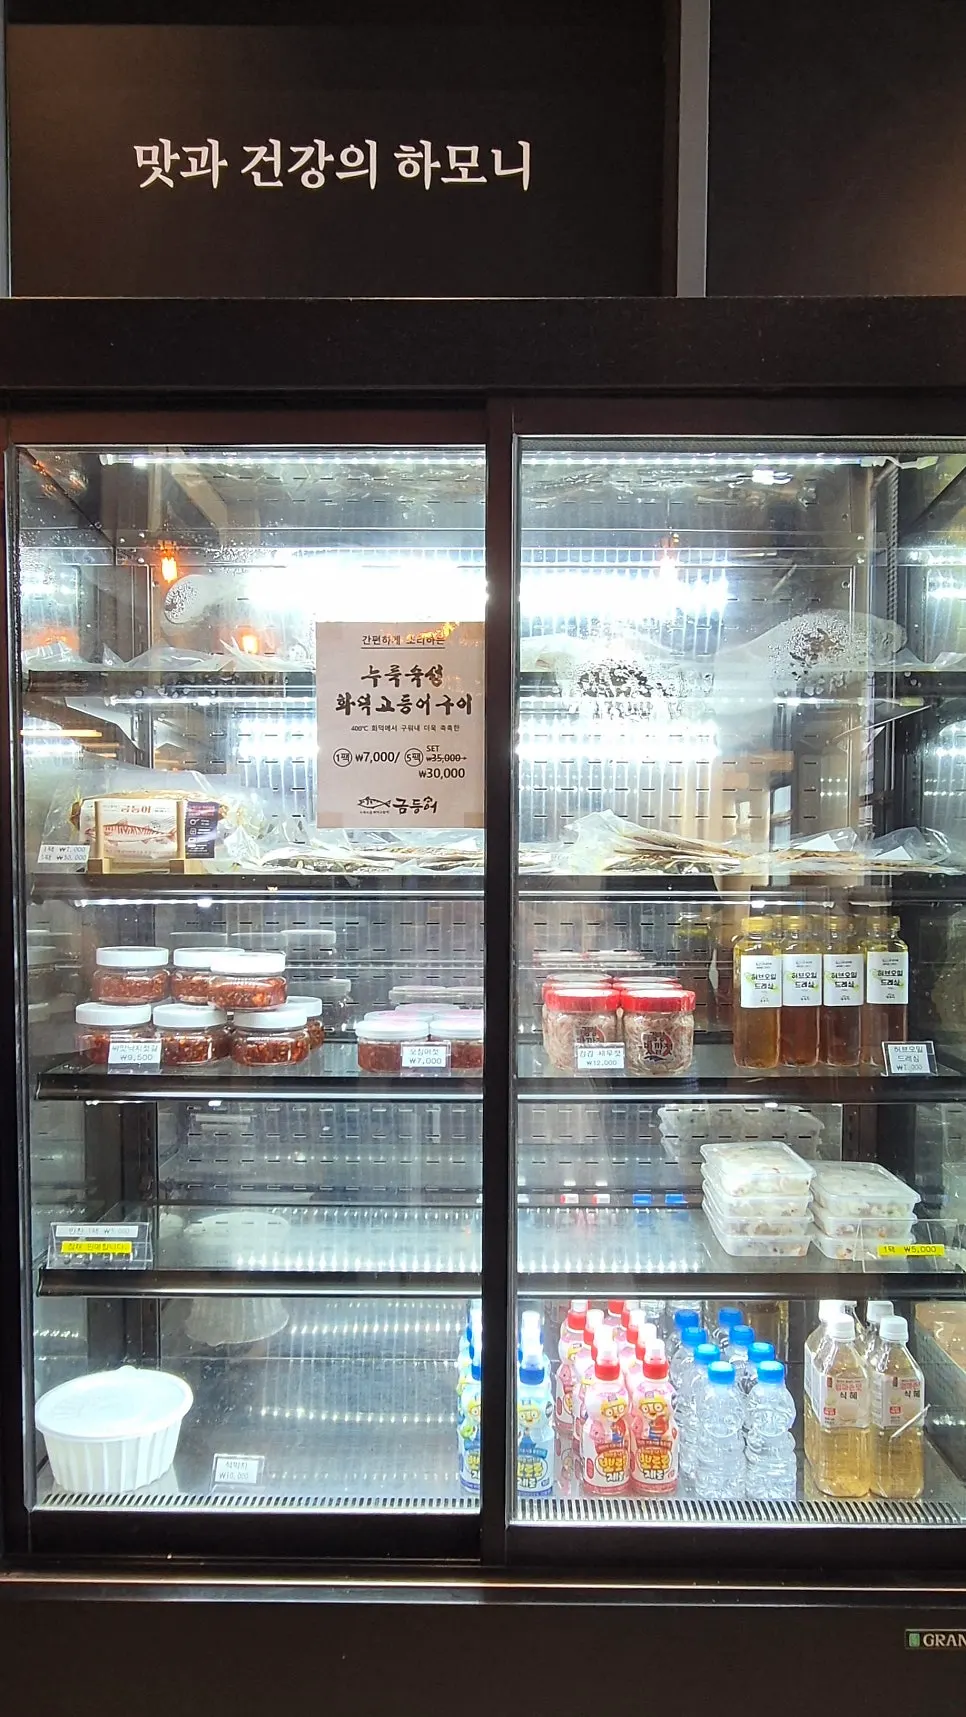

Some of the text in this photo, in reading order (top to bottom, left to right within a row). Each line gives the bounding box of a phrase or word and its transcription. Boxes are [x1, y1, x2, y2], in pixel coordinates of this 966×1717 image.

[134, 138, 532, 191] 맛과 건강의 하모니
[362, 635, 400, 646] 간편하게
[418, 768, 466, 780] ₩30,000
[410, 1057, 442, 1065] ₩7,000
